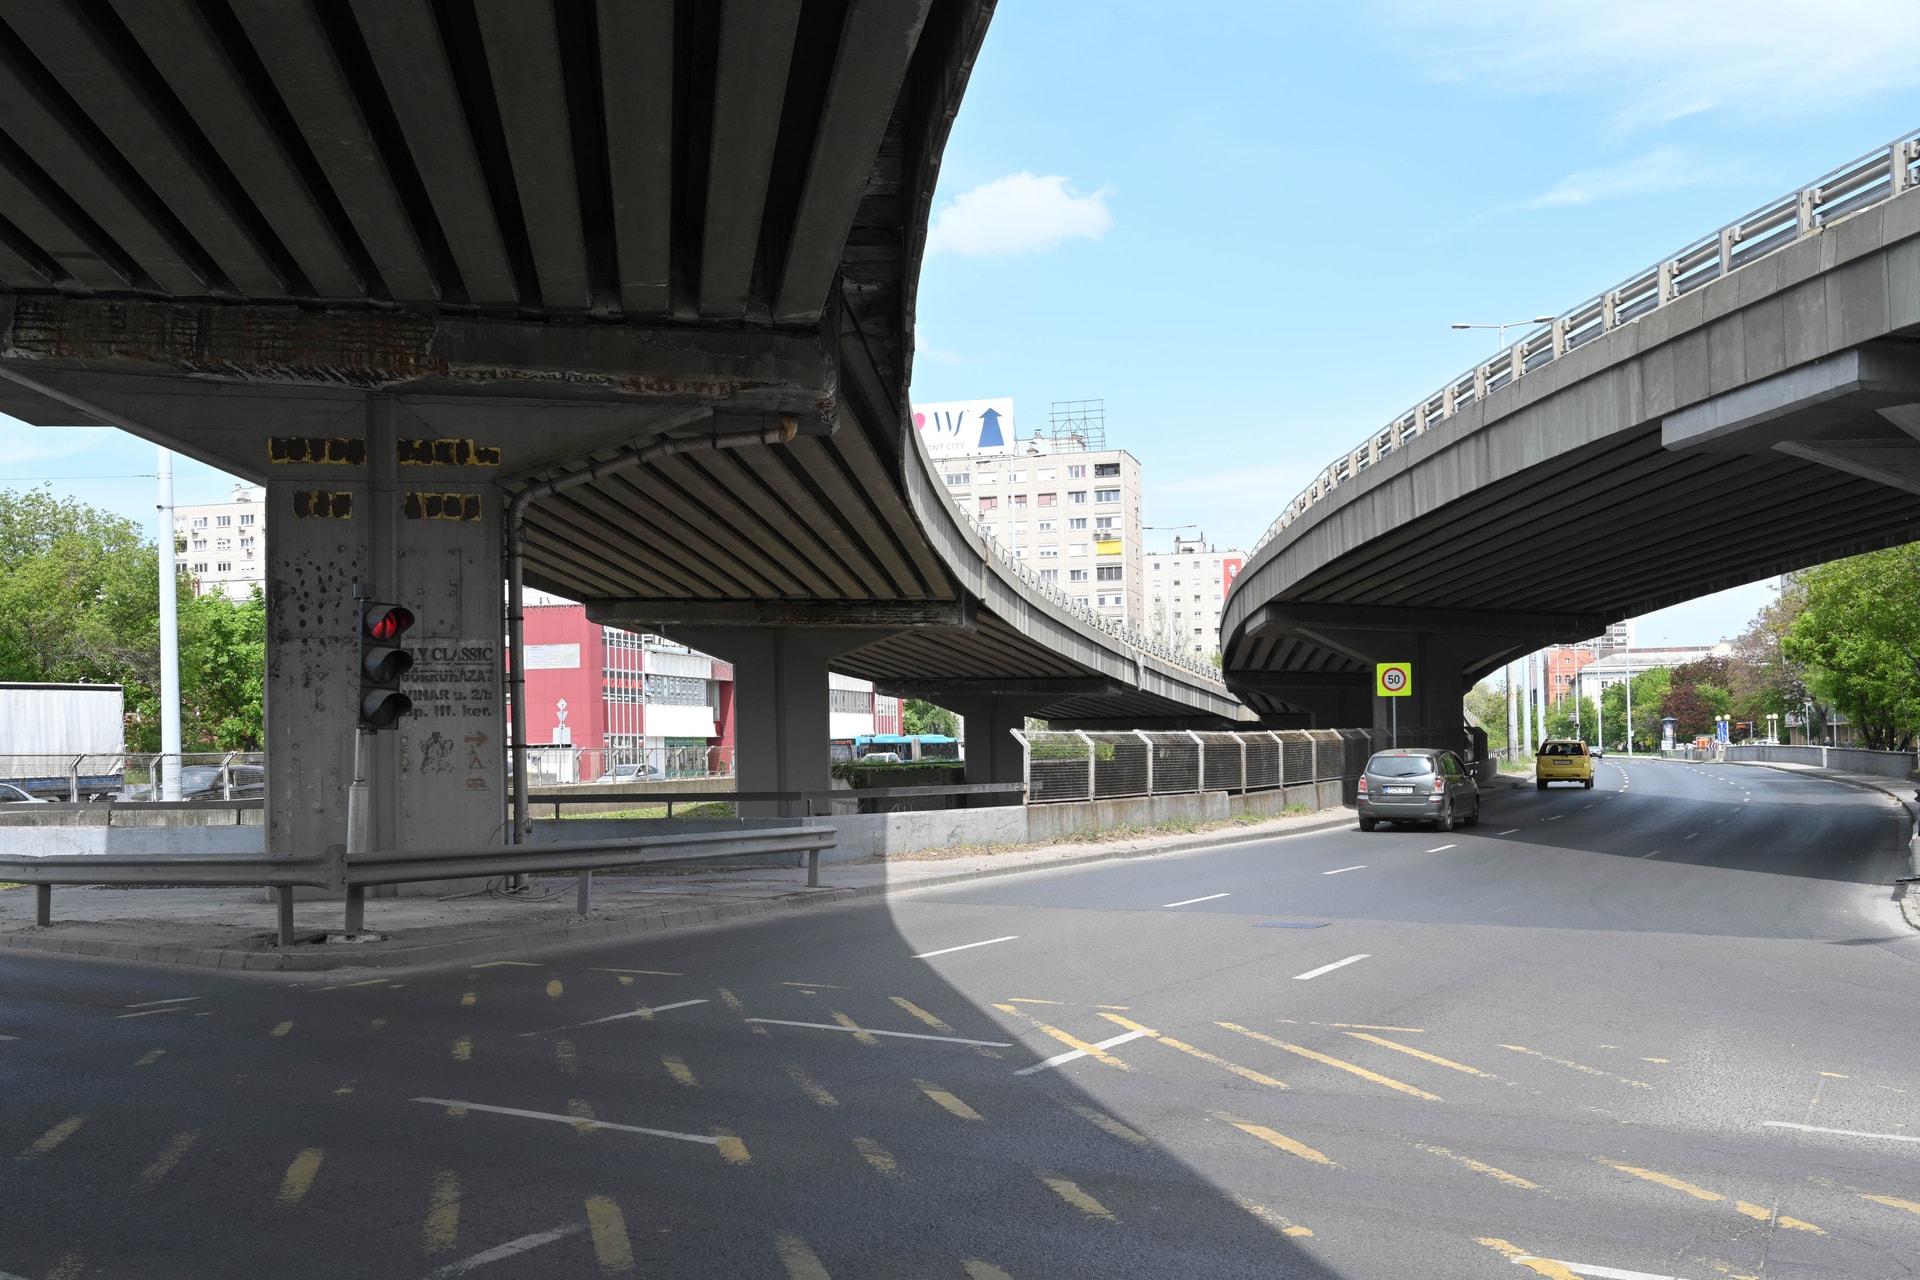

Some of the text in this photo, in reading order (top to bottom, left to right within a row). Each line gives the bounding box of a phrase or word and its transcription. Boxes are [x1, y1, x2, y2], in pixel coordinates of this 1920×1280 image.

[946, 442, 965, 450] CITY
[432, 647, 493, 661] CLASSIC
[1388, 674, 1400, 685] 50
